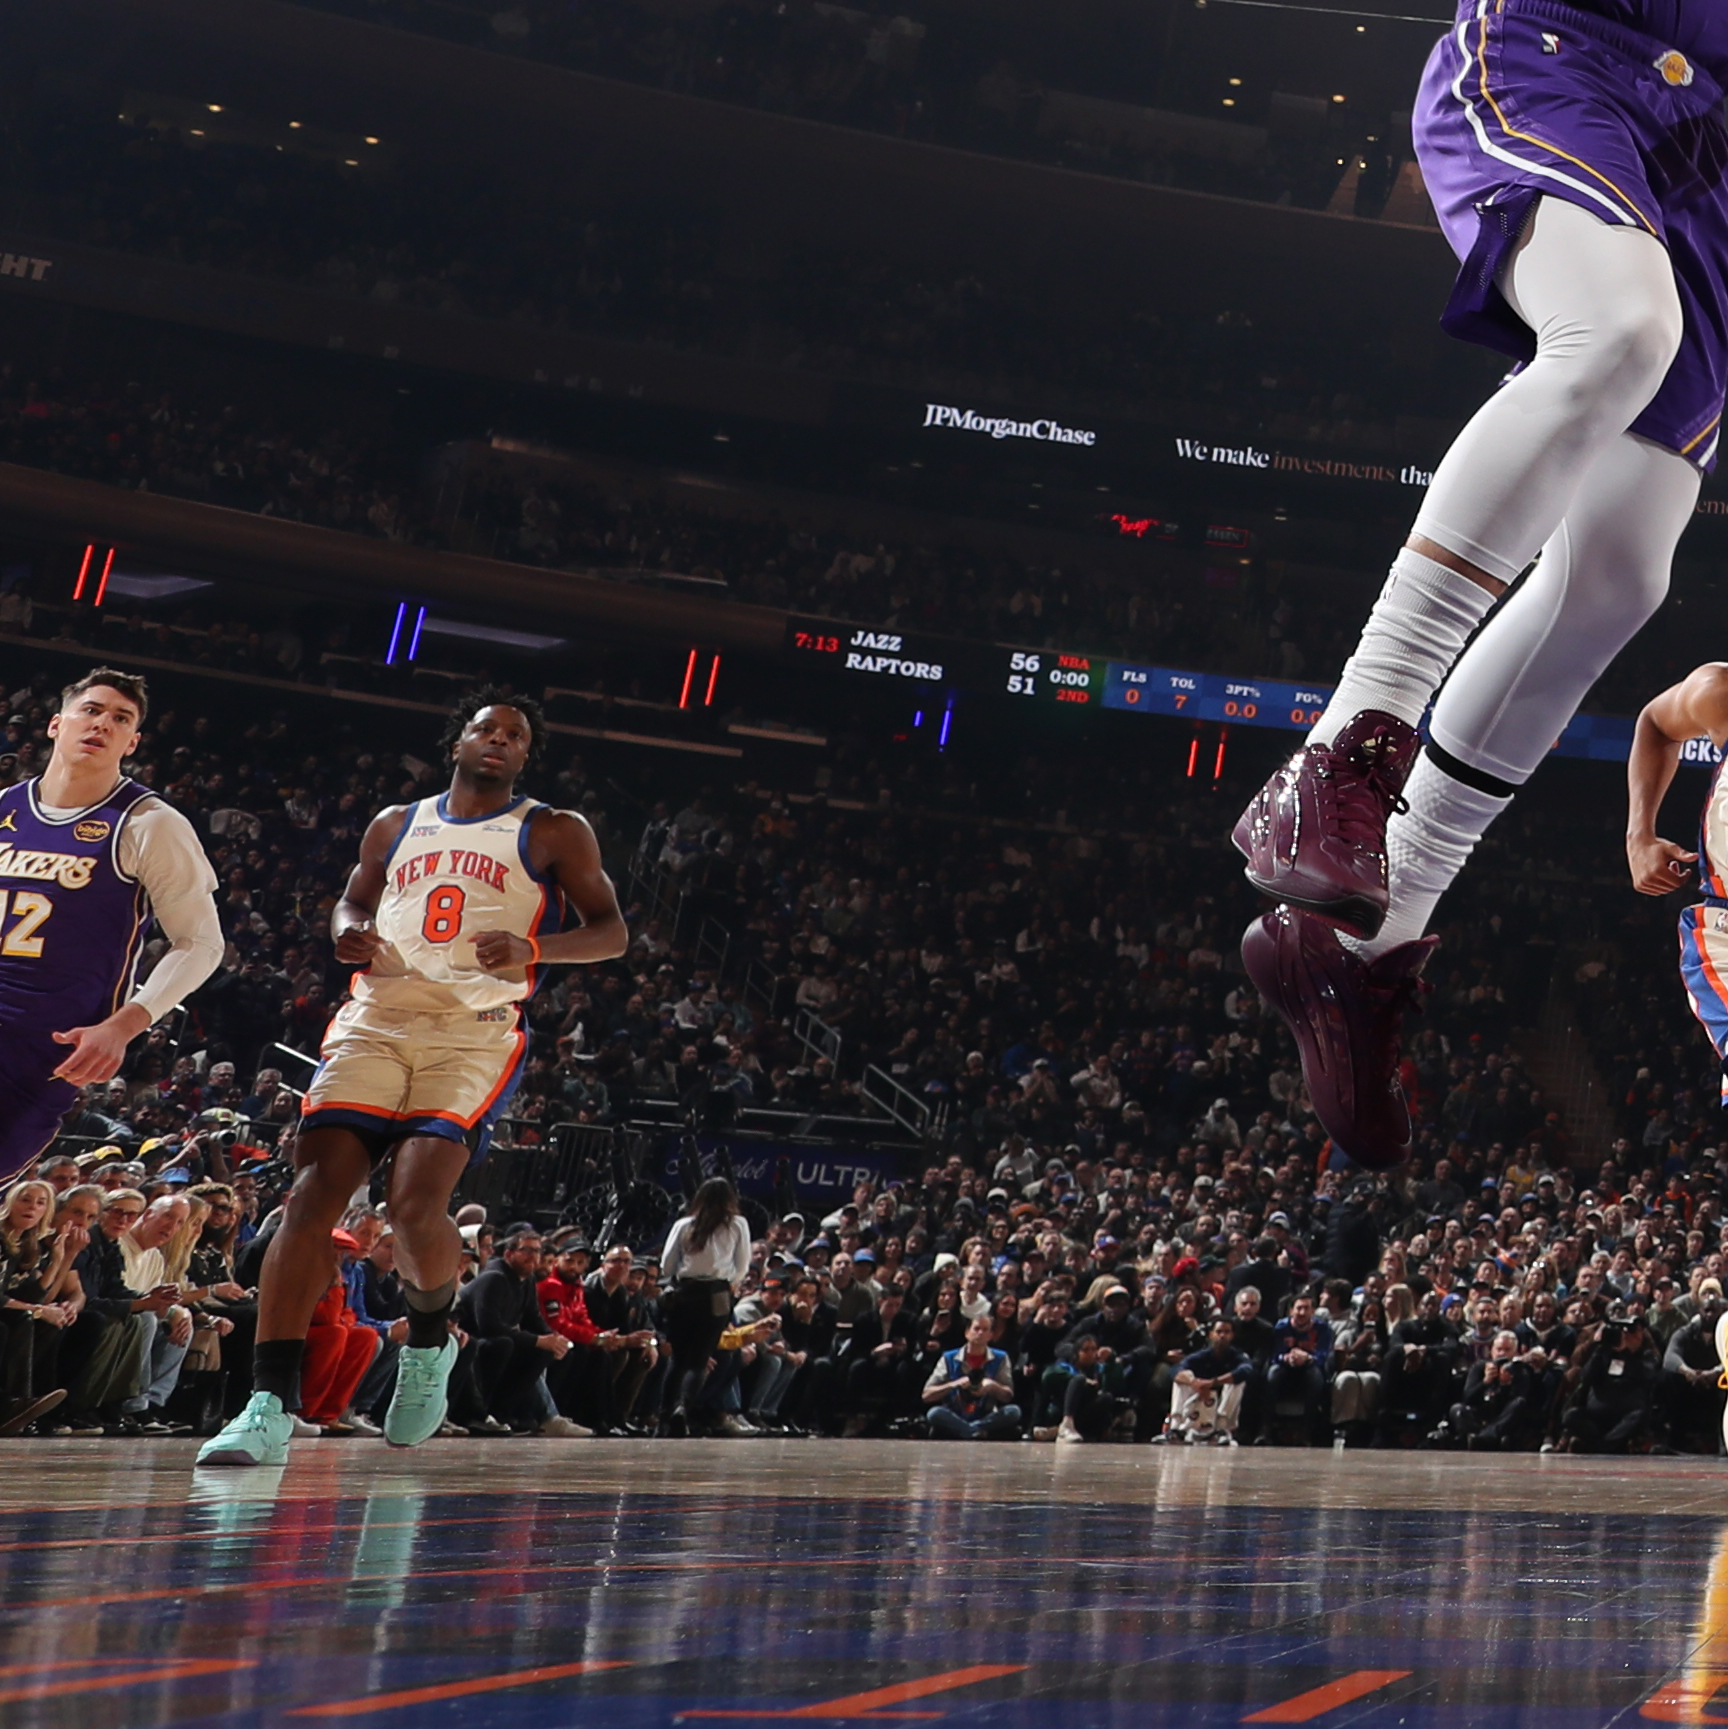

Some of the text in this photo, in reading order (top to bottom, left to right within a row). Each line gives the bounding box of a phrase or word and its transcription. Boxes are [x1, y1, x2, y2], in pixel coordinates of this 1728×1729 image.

[923, 404, 1096, 446] JPMorganChase
[1175, 438, 1435, 486] We make investments tha
[795, 632, 839, 653] 7:13
[851, 631, 902, 651] JAZZ
[846, 653, 943, 681] RAPTORS
[1010, 653, 1040, 672] 56
[1058, 655, 1090, 670] NBA
[1007, 675, 1035, 696] 51
[1049, 669, 1089, 688] 0:00
[1122, 670, 1147, 684] FLS
[1170, 677, 1196, 690] TOL
[1225, 684, 1260, 699] 3PT%
[1056, 689, 1089, 703] 2ND
[1125, 689, 1257, 719] 0 7 0.0
[396, 849, 509, 894] NEW YORK
[422, 885, 466, 943] 8
